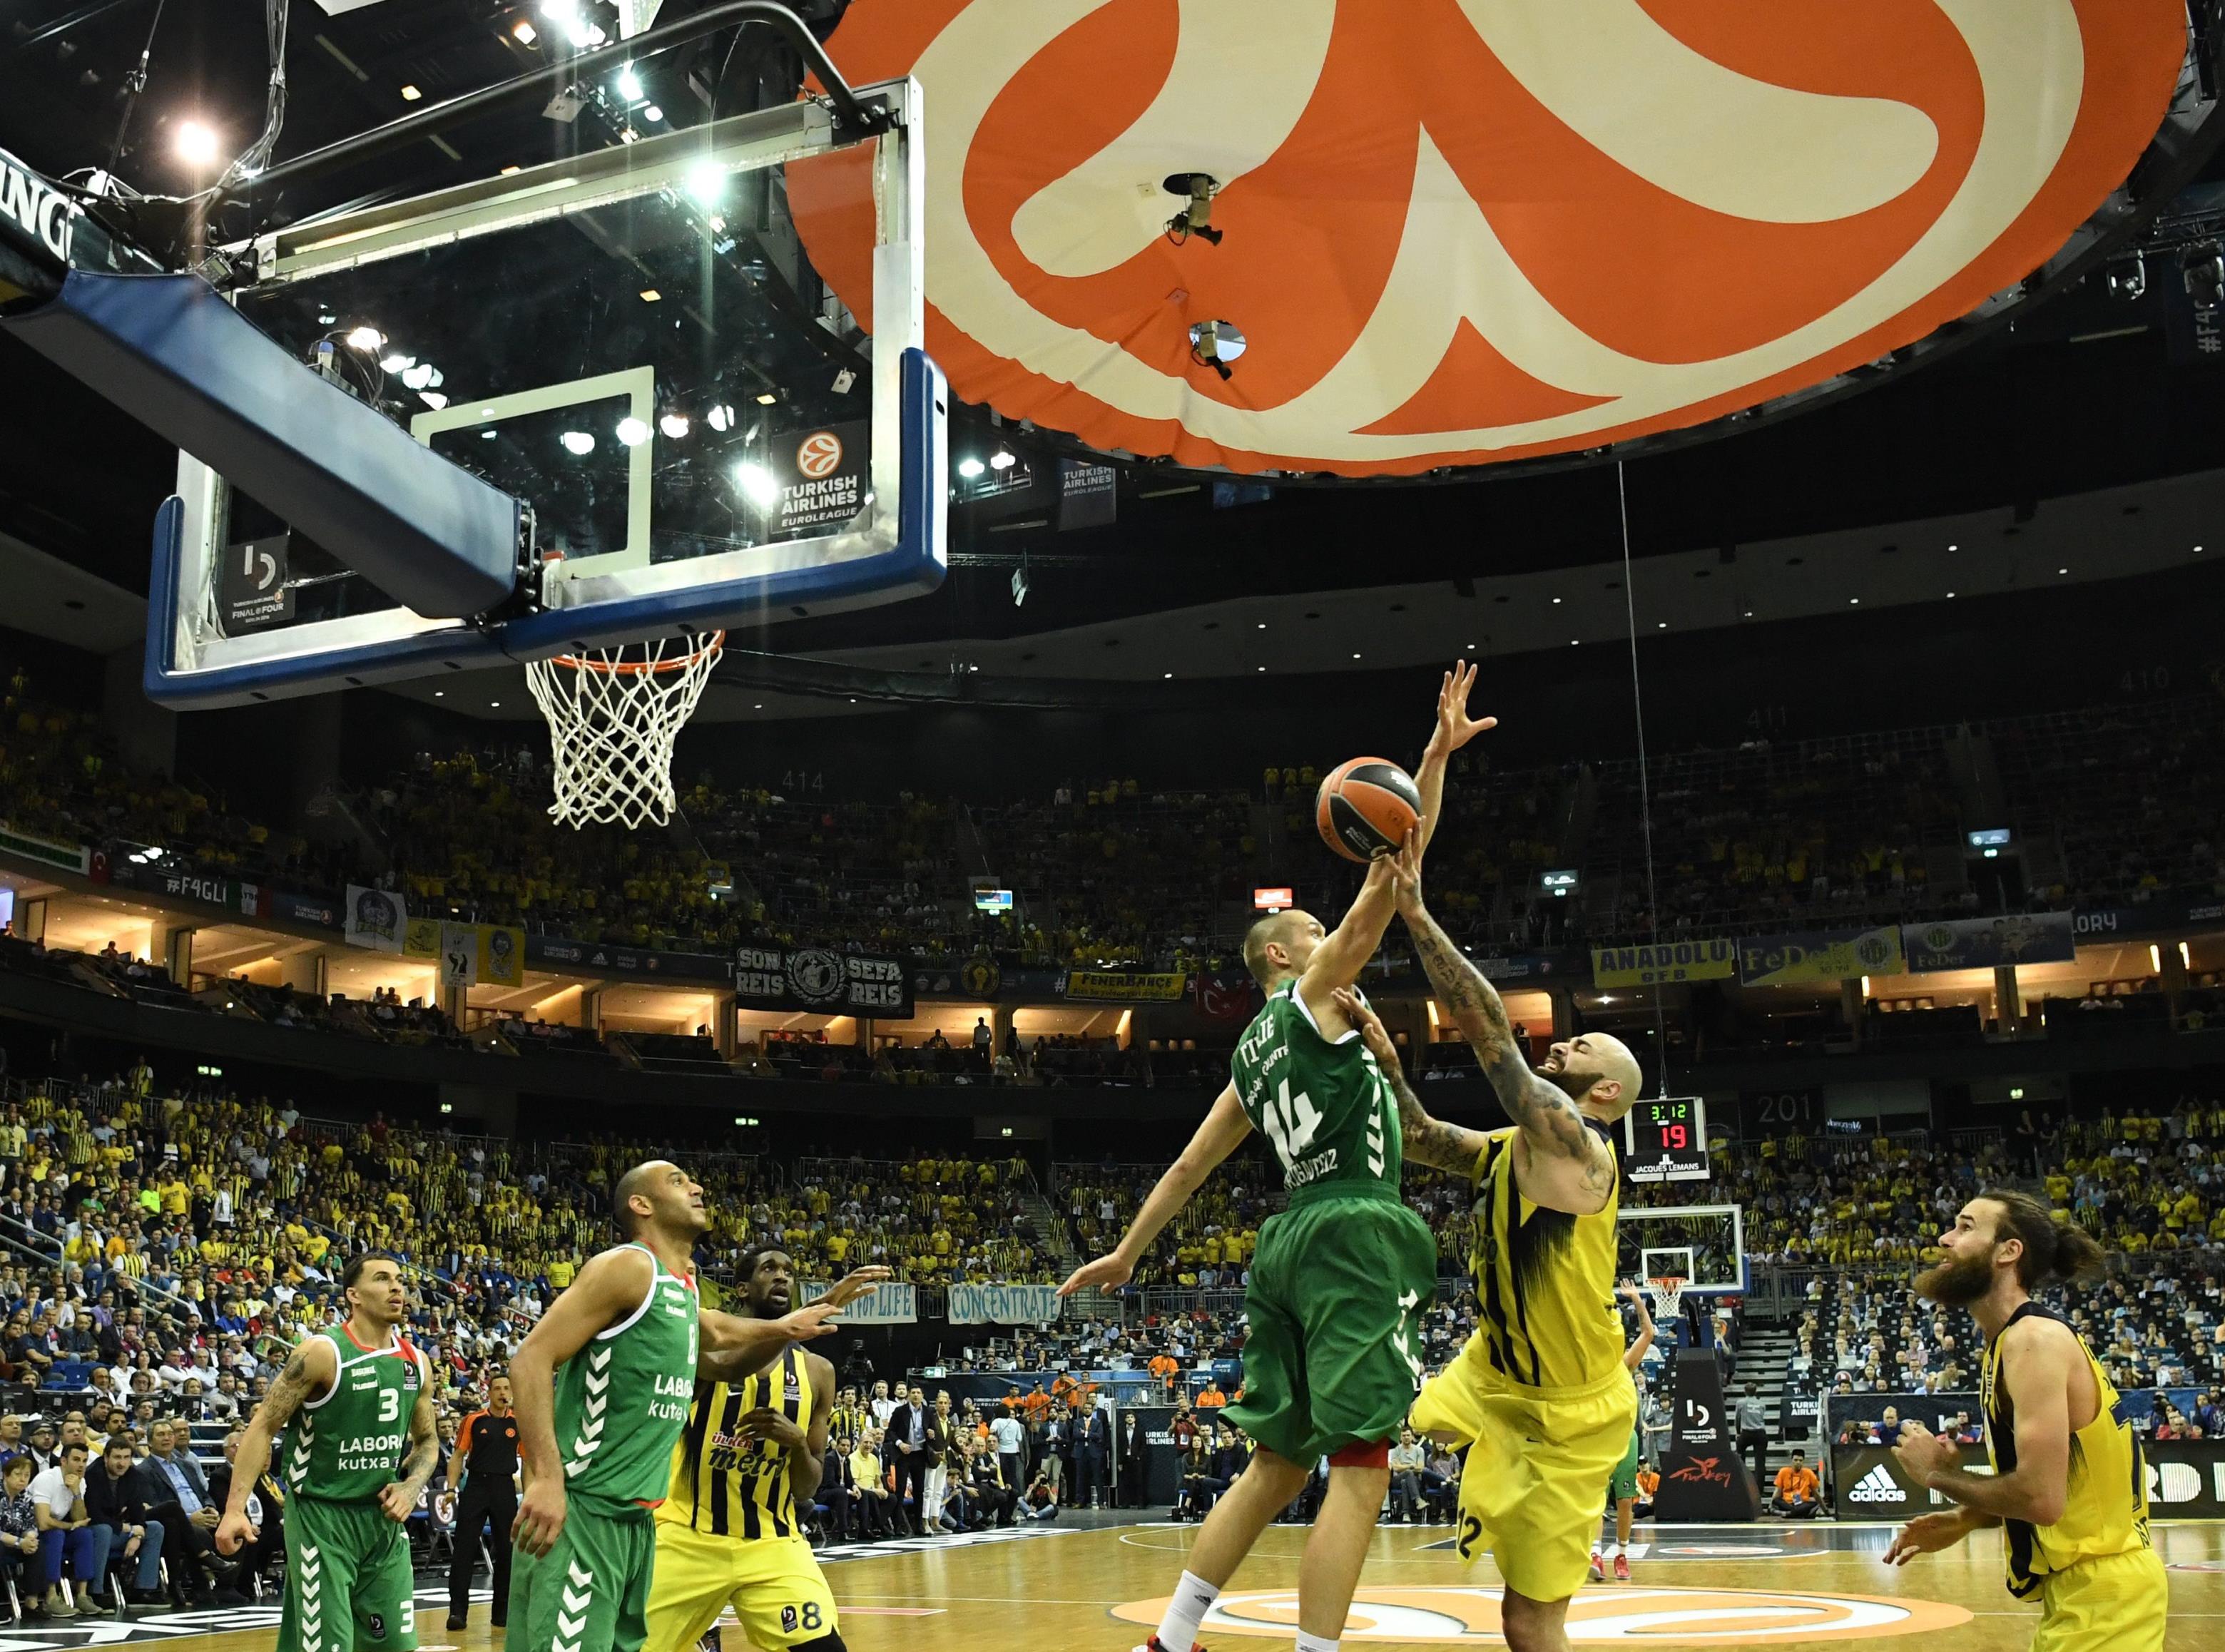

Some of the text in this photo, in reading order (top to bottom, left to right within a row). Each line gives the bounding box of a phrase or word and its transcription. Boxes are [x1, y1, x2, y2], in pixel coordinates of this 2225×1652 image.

[1063, 466, 1112, 481] TURKISH
[1063, 474, 1113, 490] AIRLINES
[782, 475, 858, 500] TURKISH
[781, 490, 858, 516] AIRLINES
[781, 507, 858, 528] EUROLEAGUE
[232, 608, 255, 619] FINAL
[262, 603, 284, 614] FOUR
[782, 770, 825, 794] 414
[739, 949, 780, 970] SON
[847, 957, 903, 981] SEFA
[1600, 941, 1727, 972] ANADOLU
[737, 972, 784, 996] REIS
[850, 981, 903, 1006] REIS
[1757, 1092, 1811, 1123] 201
[1263, 1077, 1323, 1171] 14
[1661, 1124, 1687, 1149] 19
[1634, 1162, 1699, 1173] JACQUES LEMANS
[878, 1285, 912, 1317] LIFE
[951, 1286, 1058, 1320] CONCENTRATE
[378, 1387, 399, 1422] 3
[712, 1432, 754, 1451] ÜLKER
[338, 1456, 390, 1471] kutxa
[1848, 1487, 1907, 1502] adidas
[1457, 1506, 1482, 1560] 12
[399, 1600, 414, 1633] 3
[801, 1601, 823, 1631] 8
